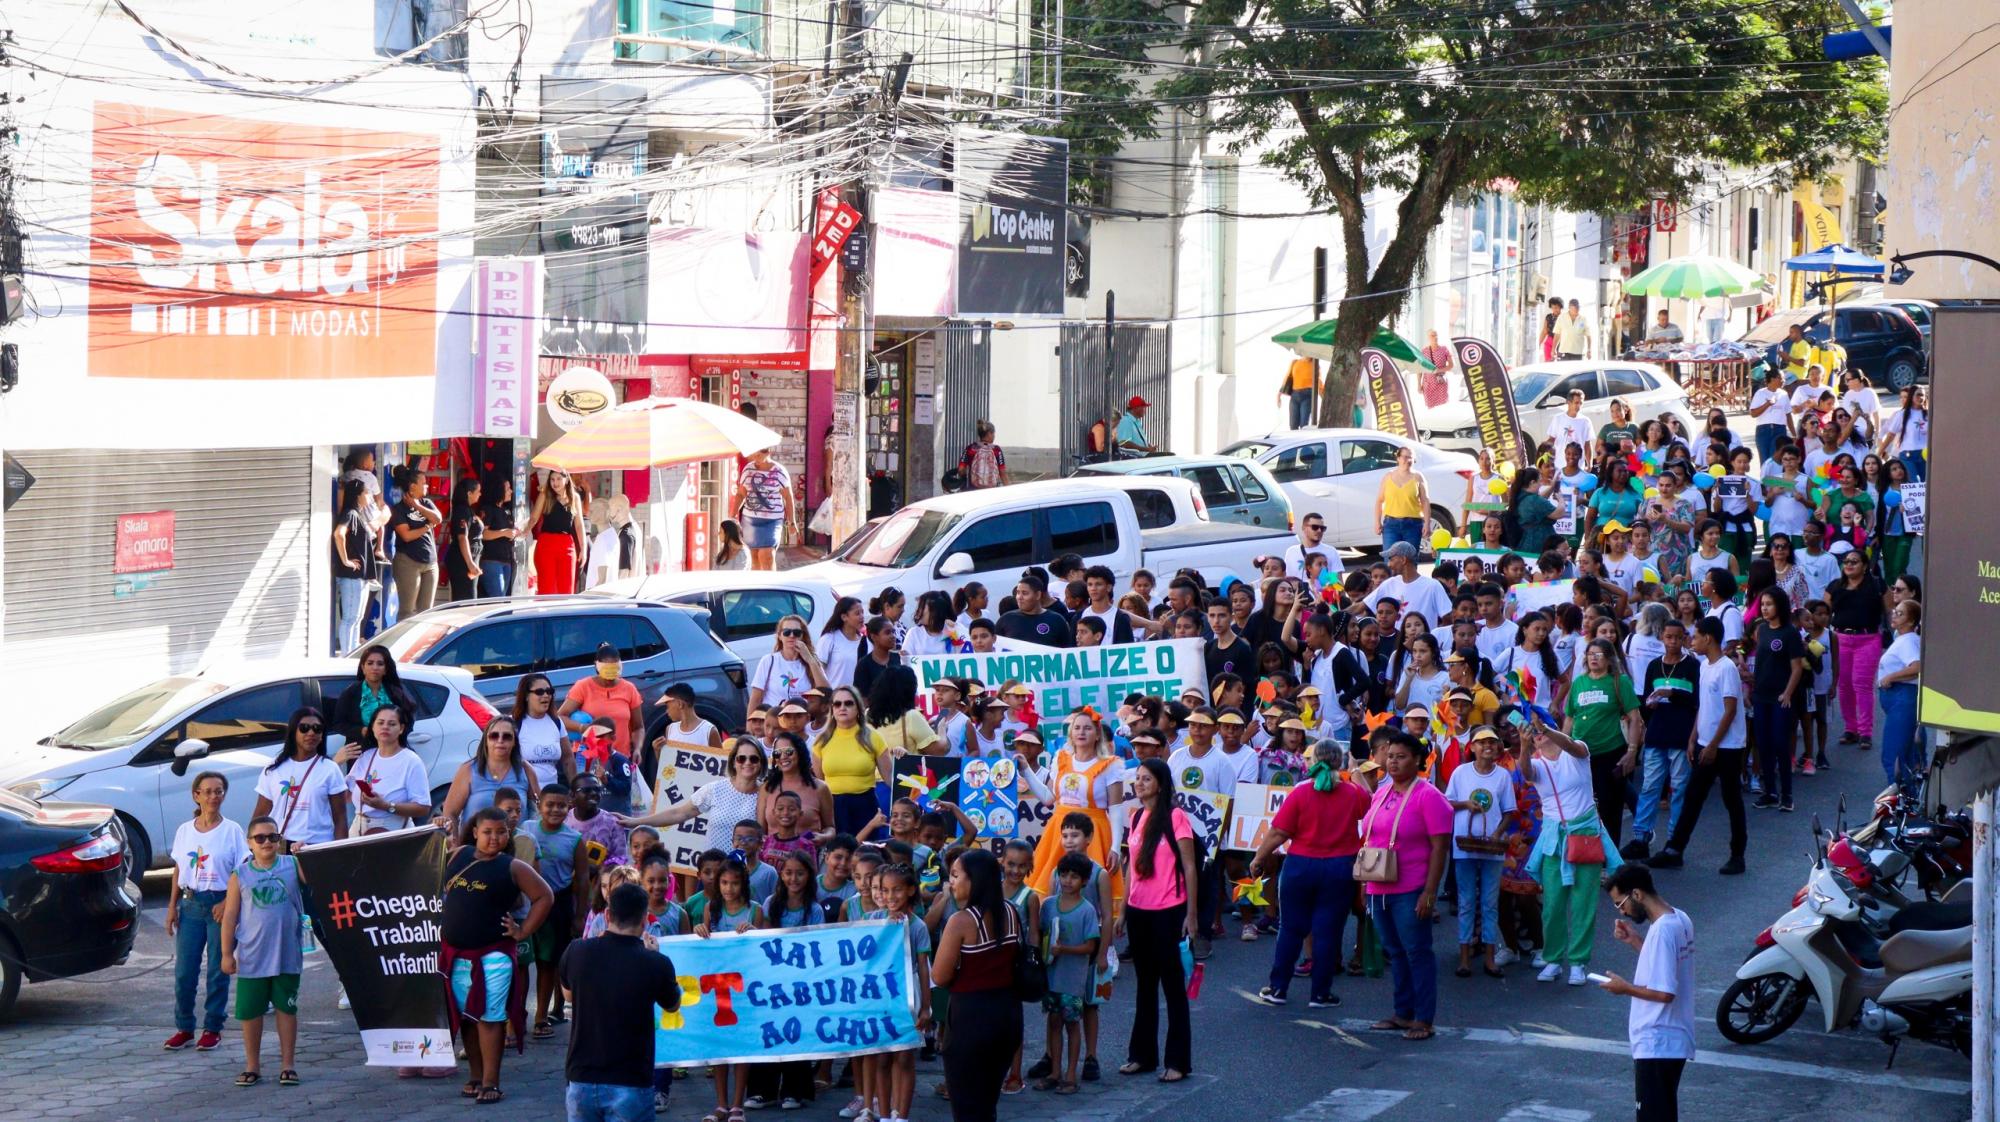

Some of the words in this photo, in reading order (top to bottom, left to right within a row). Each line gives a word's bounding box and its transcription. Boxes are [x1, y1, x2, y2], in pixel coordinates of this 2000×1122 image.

[131, 154, 370, 294] Skala
[992, 208, 1017, 242] Top
[1018, 210, 1055, 242] Center
[291, 309, 370, 338] MODAS
[491, 271, 518, 427] DENTISTAS
[1491, 386, 1517, 450] ROTATIVO
[124, 519, 149, 534] Skala
[986, 647, 1147, 687] NORMALIZE
[1156, 645, 1176, 675] O
[1042, 683, 1098, 718] ELE
[329, 890, 428, 930] #Chega
[429, 894, 443, 914] de
[380, 951, 439, 976] Infantil
[760, 938, 823, 969] VAI
[838, 934, 877, 966] DO
[760, 1016, 803, 1049] AO
